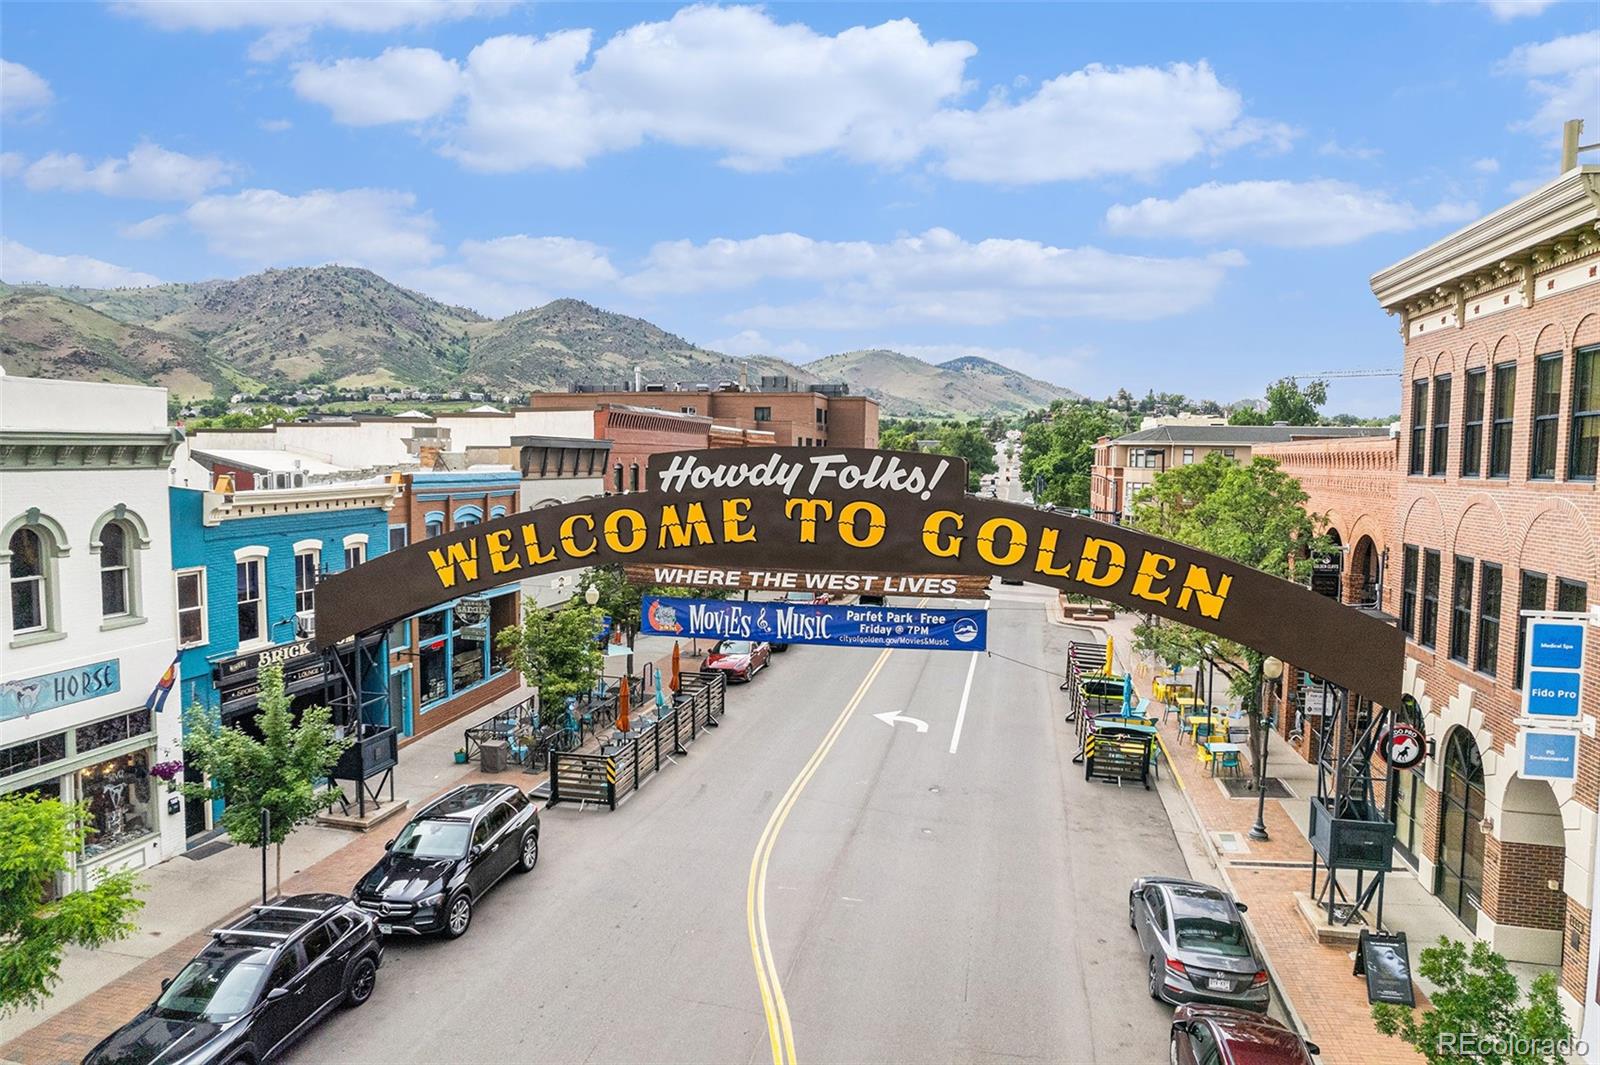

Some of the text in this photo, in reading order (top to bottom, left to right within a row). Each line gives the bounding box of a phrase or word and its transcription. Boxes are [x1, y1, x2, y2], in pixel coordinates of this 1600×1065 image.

[659, 453, 950, 501] Howdy Folks!
[427, 497, 1233, 621] WELCOME TO GOLDEN
[654, 568, 958, 595] WHERE THE WEST LIVES
[846, 610, 946, 625] Parfet Park Free
[859, 623, 929, 636] Friday @ 7PM
[258, 641, 311, 667] BRICK
[297, 667, 320, 679] LOUNGE
[54, 665, 113, 702] HORSE
[1531, 688, 1577, 699] Fido Pro
[1404, 729, 1418, 738] PRO
